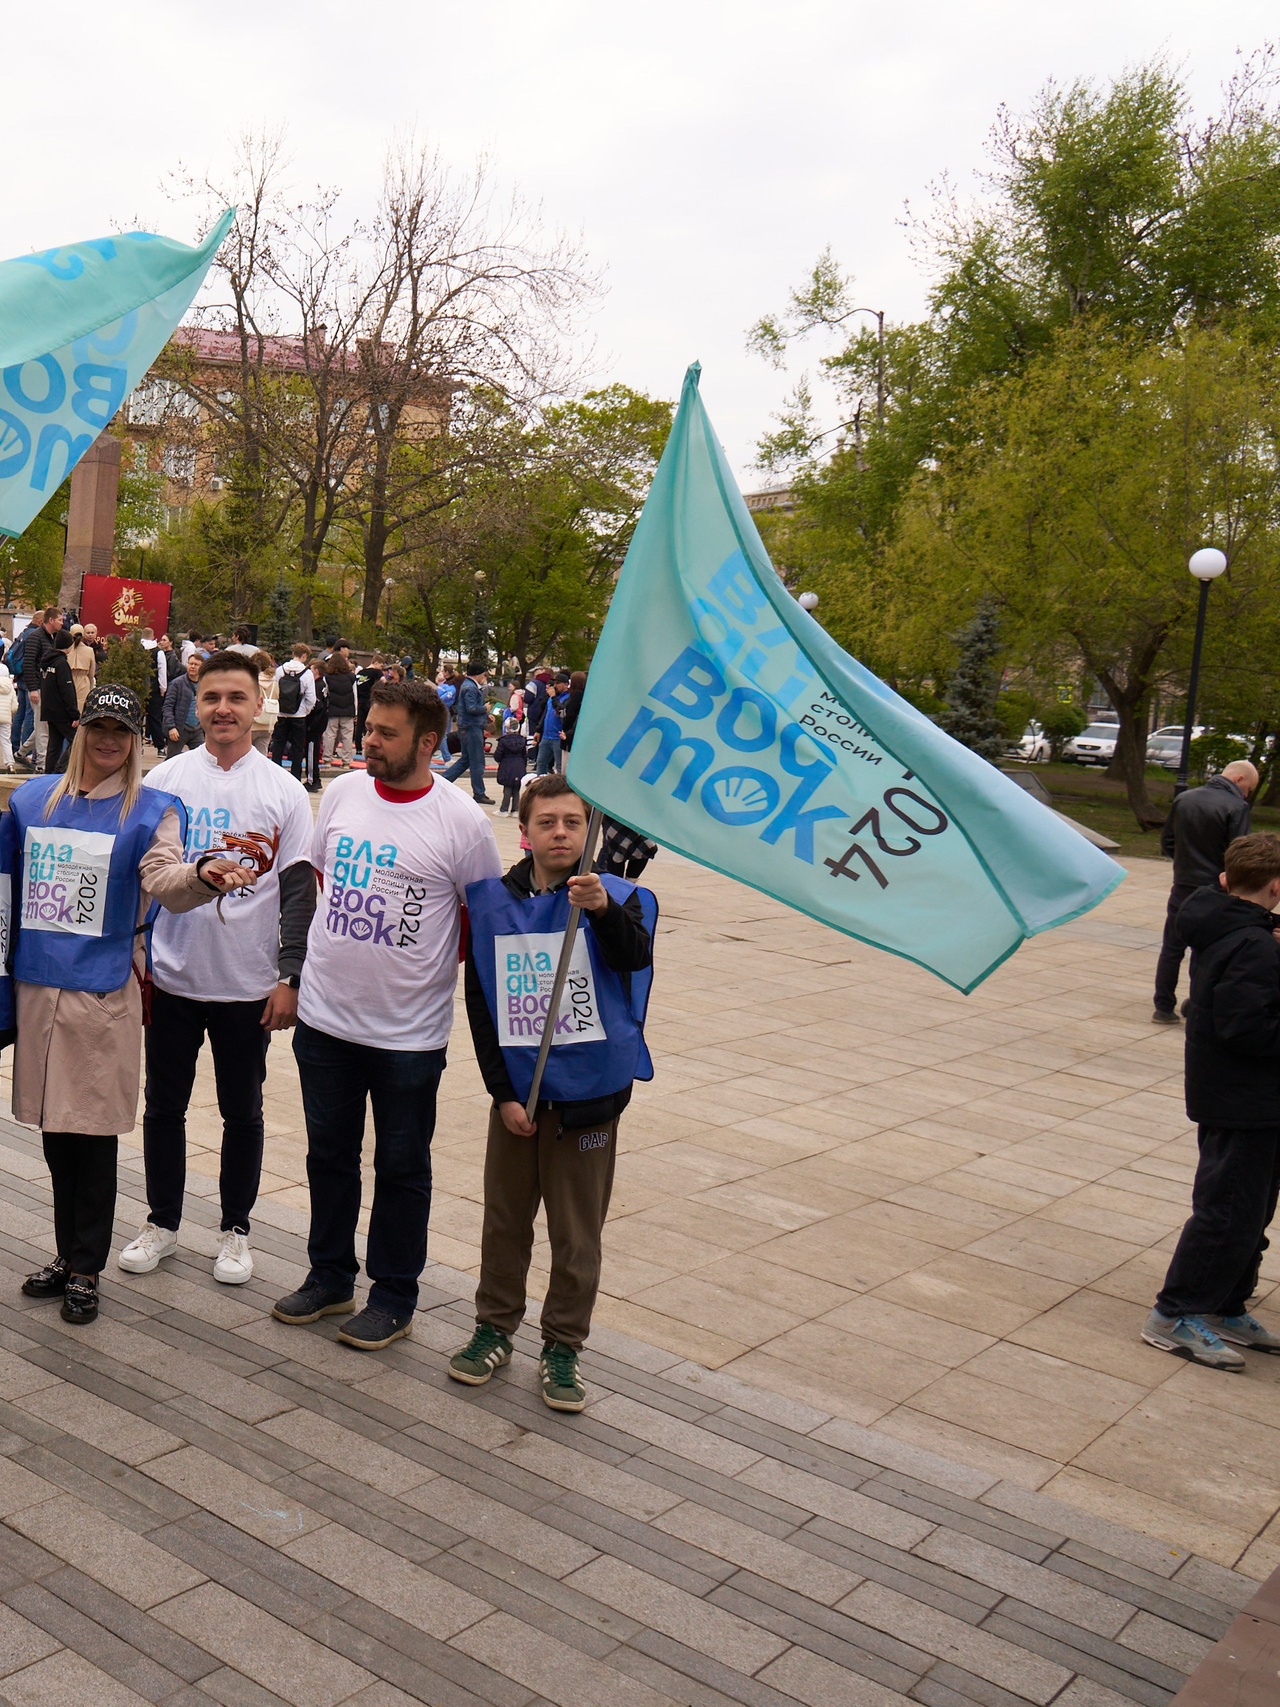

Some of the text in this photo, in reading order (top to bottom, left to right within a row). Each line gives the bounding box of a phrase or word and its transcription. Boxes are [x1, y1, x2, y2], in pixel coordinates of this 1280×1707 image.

[114, 608, 140, 626] 9 МАЯ
[98, 694, 130, 710] GUCCI
[799, 713, 883, 767] России
[823, 768, 949, 890] 024
[30, 842, 73, 863] вла
[335, 836, 398, 869] вла
[55, 875, 76, 883] России
[372, 876, 406, 889] столица
[28, 881, 68, 903] вос
[75, 873, 98, 925] 2024
[370, 884, 399, 896] России
[329, 884, 387, 919] вос
[396, 884, 427, 948] 2024
[506, 952, 553, 972] вла
[538, 969, 581, 979] молоная
[567, 976, 595, 1033] 2024
[579, 1131, 609, 1152] GAP
